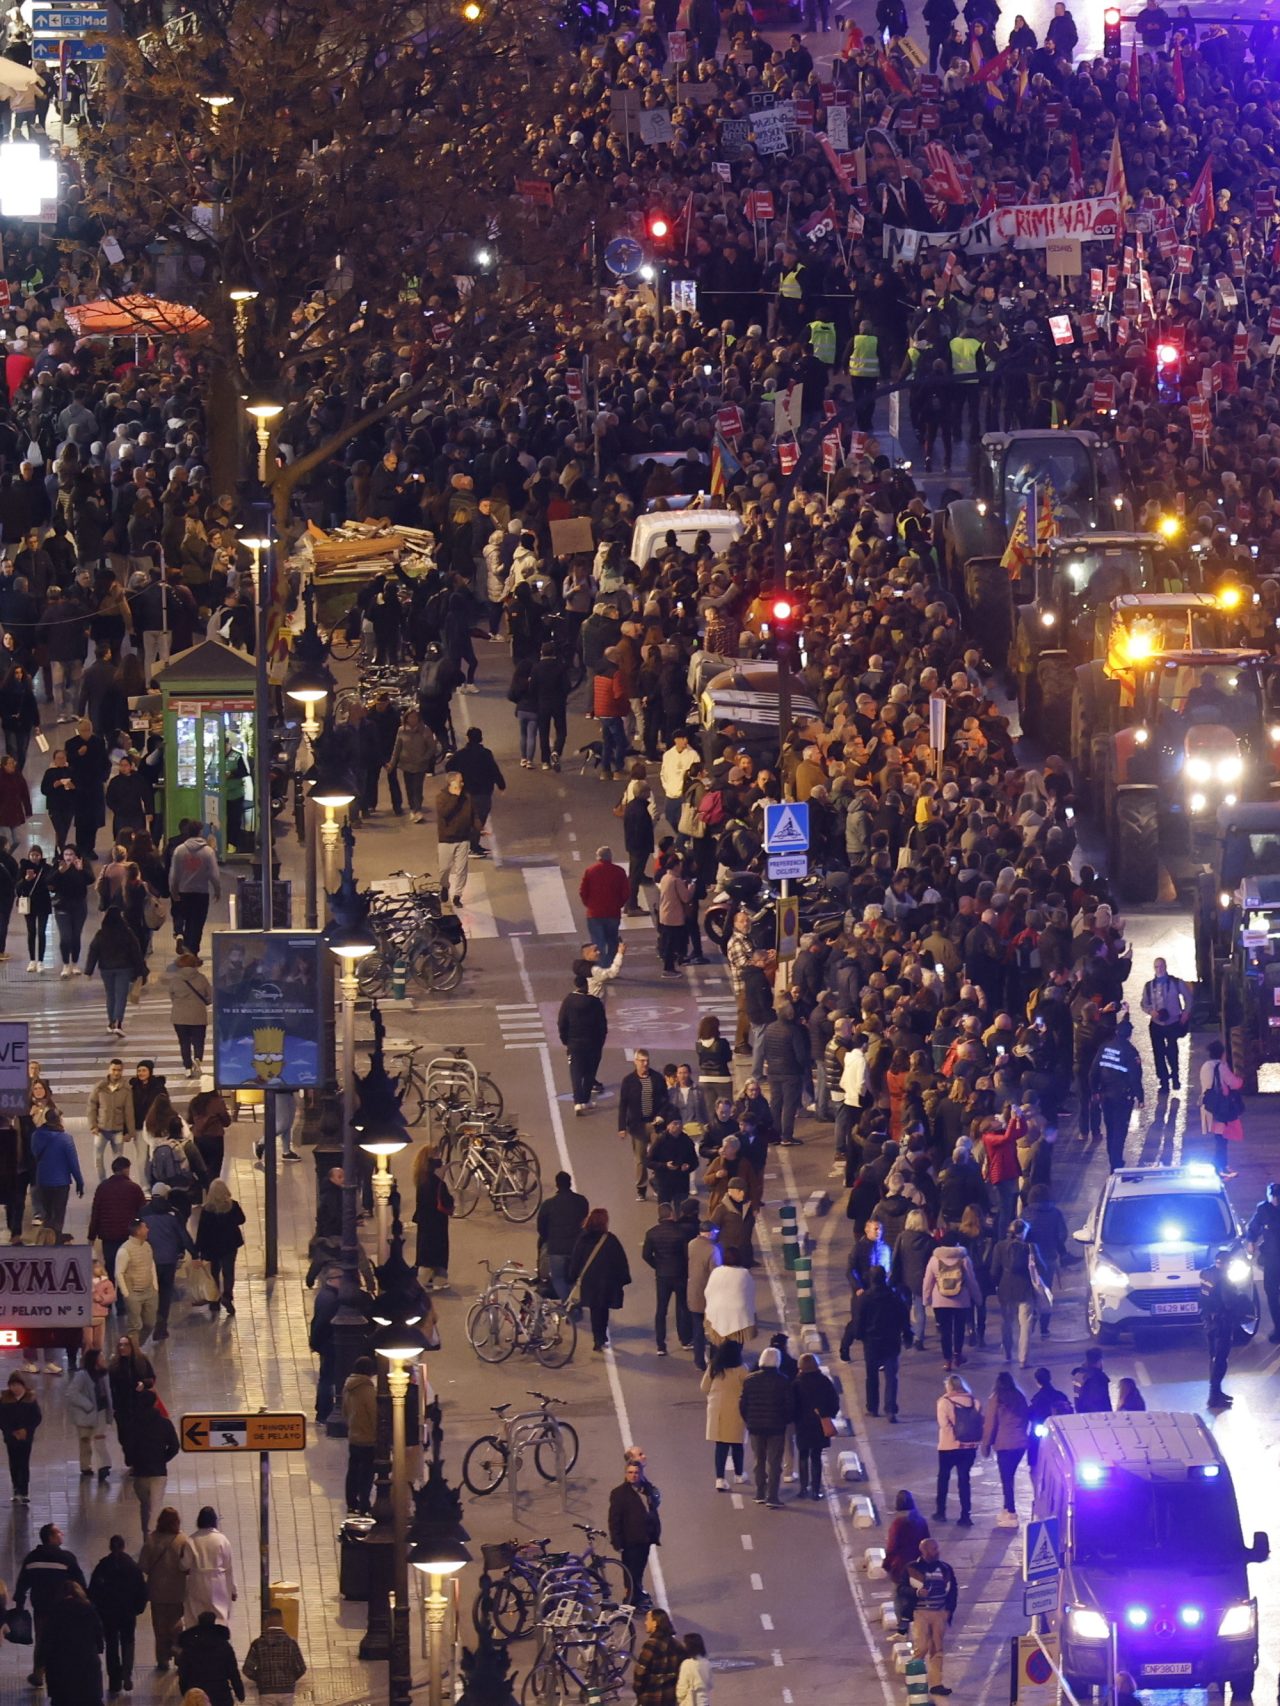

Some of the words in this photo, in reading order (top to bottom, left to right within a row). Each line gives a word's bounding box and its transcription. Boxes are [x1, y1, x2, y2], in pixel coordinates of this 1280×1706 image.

[995, 202, 1095, 240] CRIMINAL
[1094, 224, 1118, 235] CGT
[0, 1257, 87, 1294] YMA
[12, 1306, 53, 1316] PELAYO
[77, 1306, 84, 1316] 5
